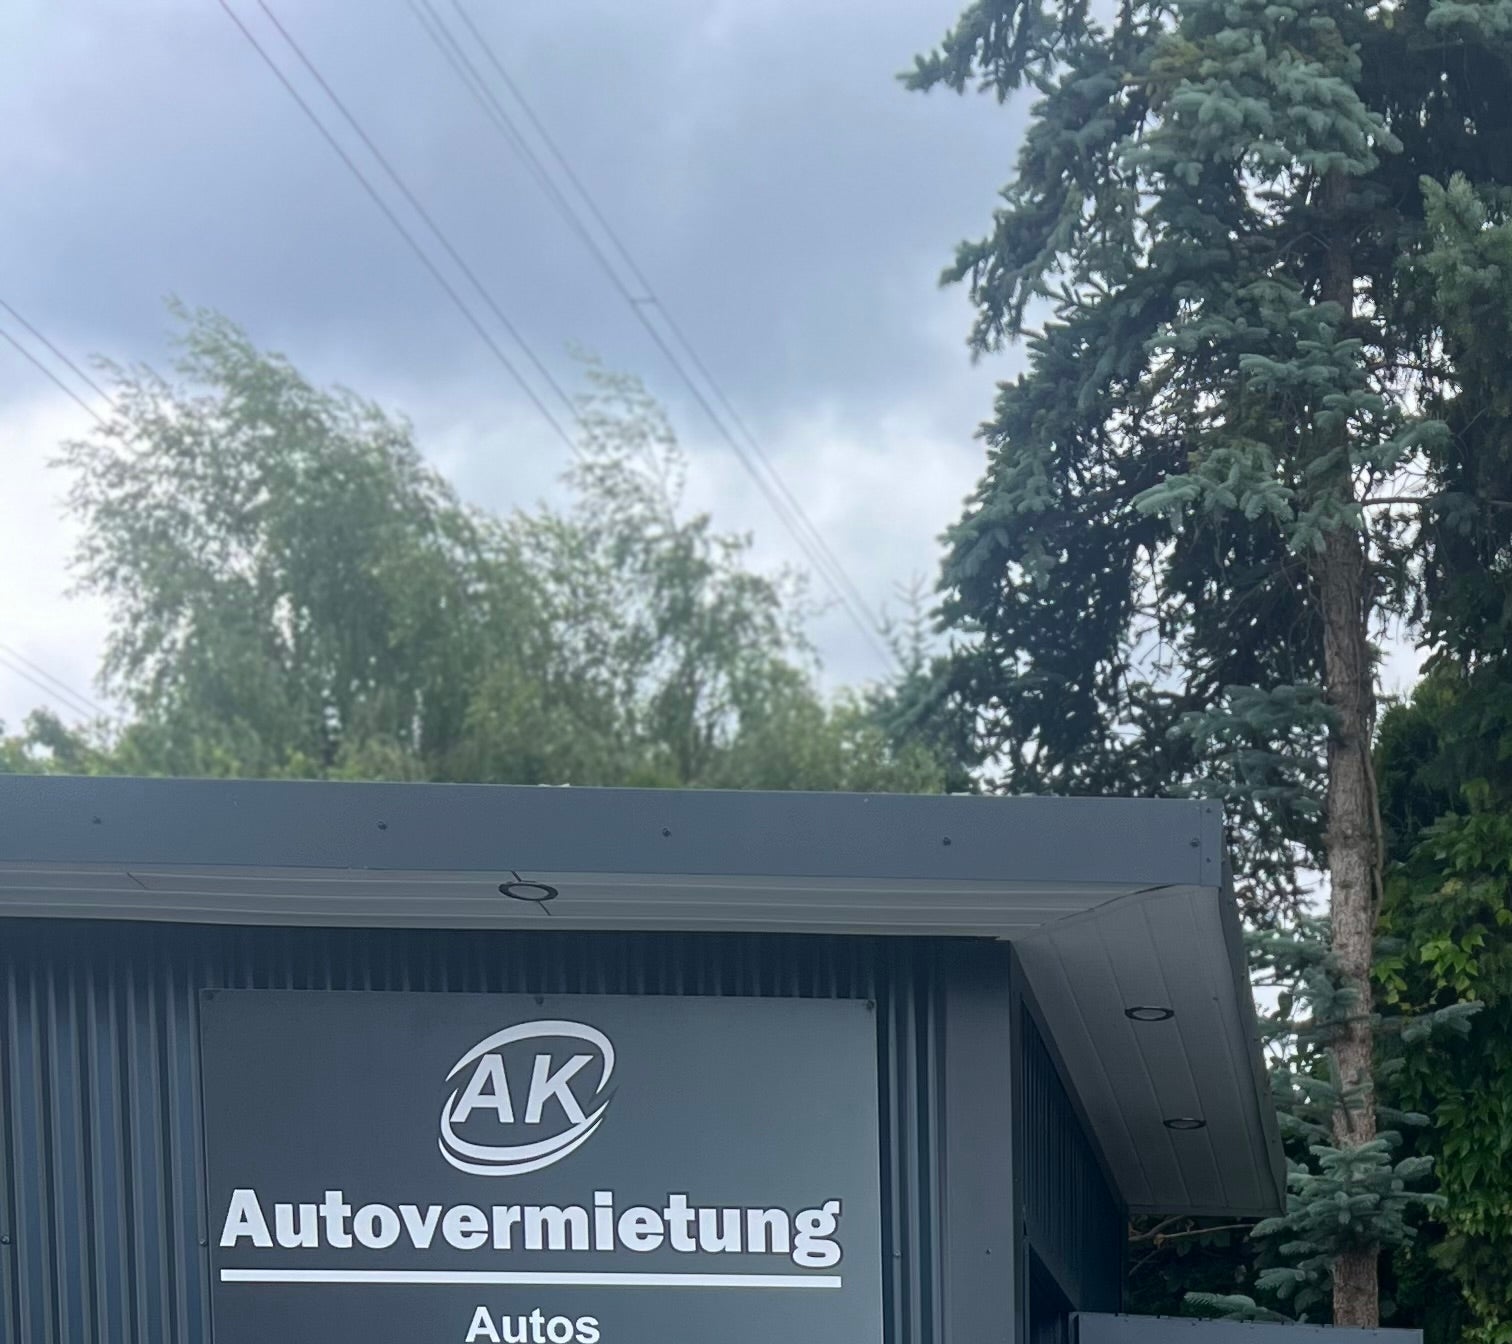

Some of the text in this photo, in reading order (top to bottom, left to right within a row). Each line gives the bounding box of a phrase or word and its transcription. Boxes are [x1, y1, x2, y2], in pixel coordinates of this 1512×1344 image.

[449, 1053, 594, 1124] AK
[219, 1189, 842, 1267] Autovermietung
[465, 1306, 600, 1344] Autos
